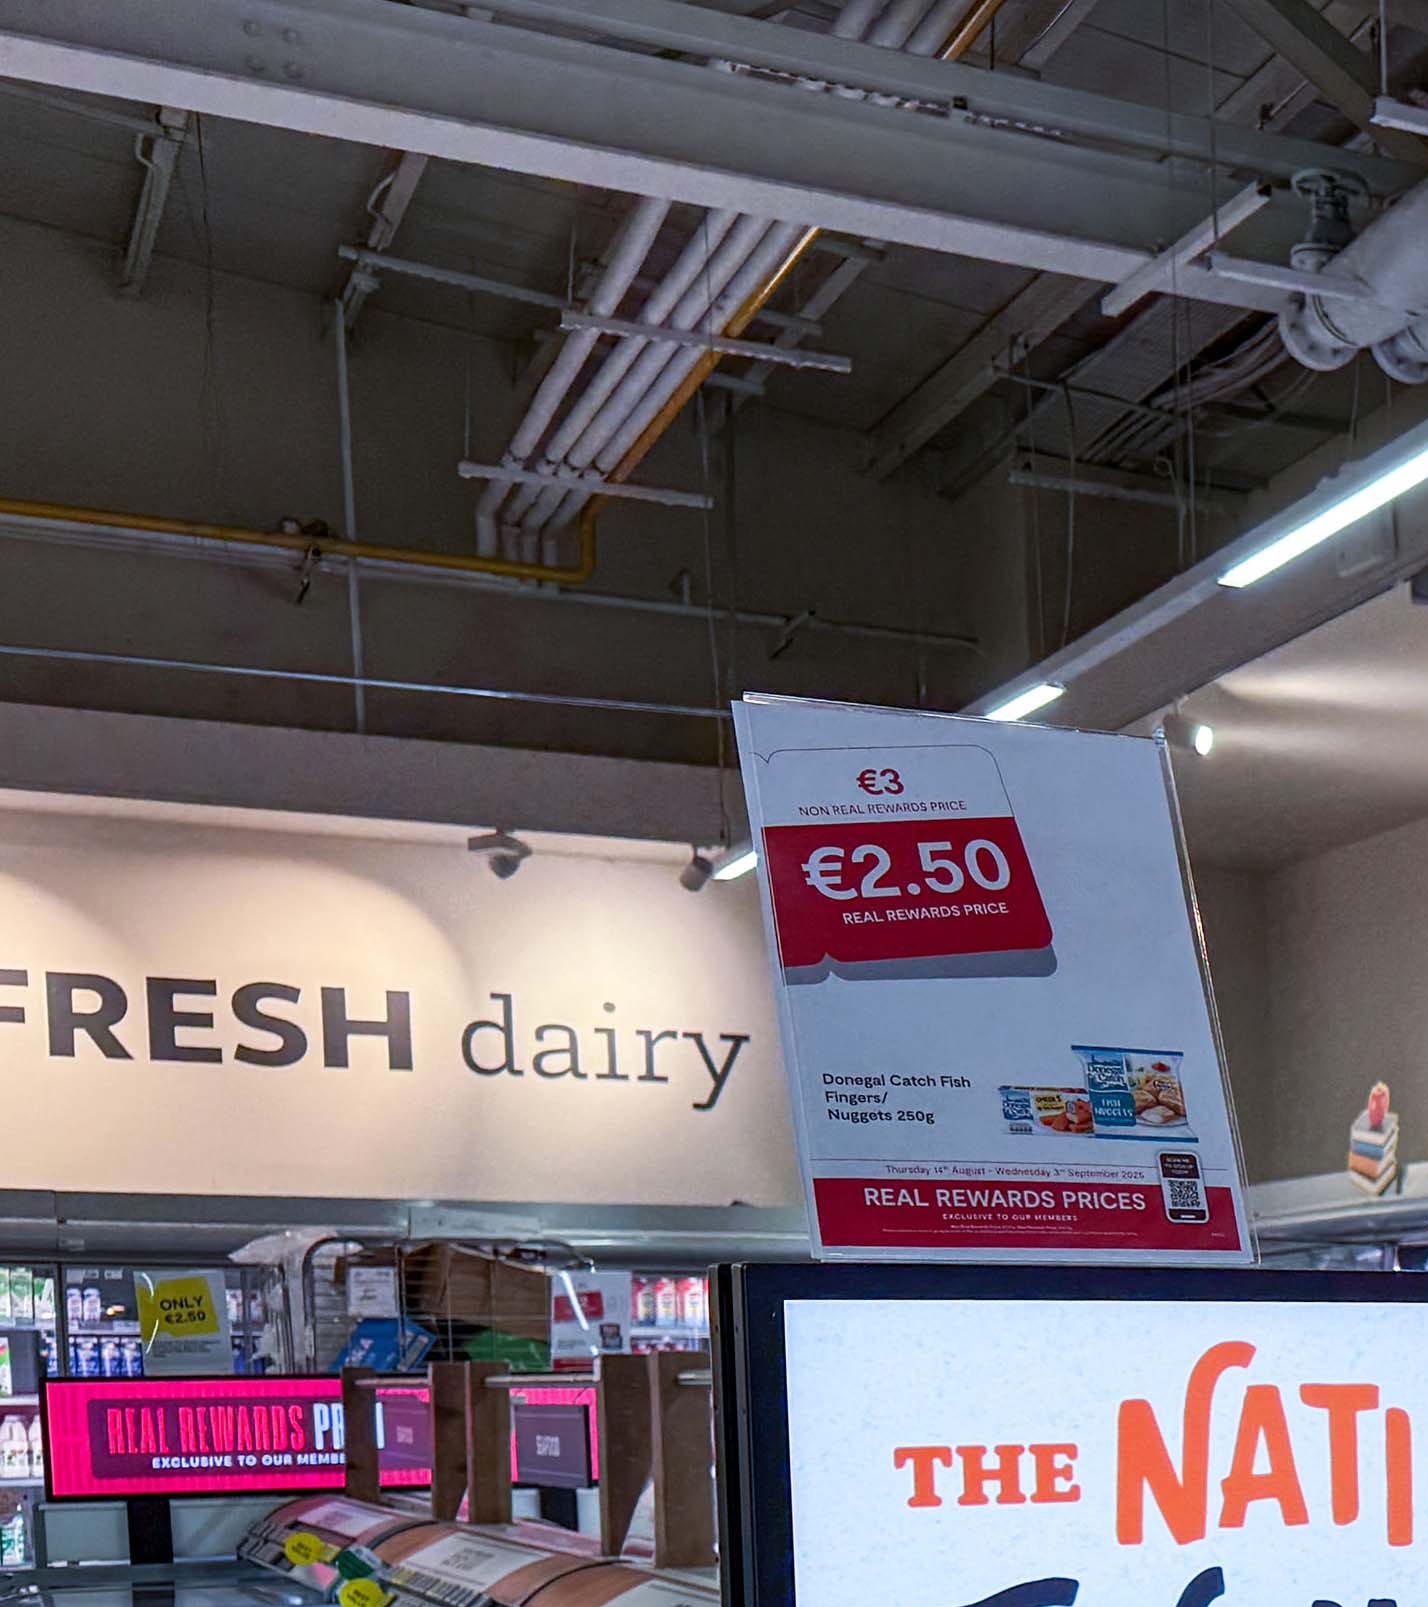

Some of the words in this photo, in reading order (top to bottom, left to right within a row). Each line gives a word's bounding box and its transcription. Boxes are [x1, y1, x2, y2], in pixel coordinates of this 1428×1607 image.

[857, 768, 904, 795] €3
[799, 804, 829, 817] NON
[833, 803, 864, 816] REAL
[867, 801, 926, 815] REWARDS
[930, 800, 966, 813] PRICE
[802, 838, 1010, 900] €2.50
[843, 911, 883, 926] REAL
[887, 905, 960, 922] REWARDS
[964, 902, 1009, 916] PRICE
[461, 993, 750, 1110] dairy
[822, 1074, 884, 1088] Donegal
[890, 1074, 936, 1086] Catch
[940, 1076, 971, 1088] Fish
[825, 1091, 888, 1106] Fingers/
[828, 1109, 892, 1124] Nuggets
[897, 1110, 935, 1124] 250g
[886, 1164, 931, 1176] Thursday
[951, 1166, 986, 1178] August
[995, 1167, 1051, 1178] Wednesday
[1068, 1169, 1119, 1180] September
[864, 1188, 929, 1207] REAL
[936, 1190, 1055, 1209] REWARDS
[1063, 1192, 1146, 1210] PRICES
[942, 1213, 994, 1222] EXCLUSIVE
[996, 1214, 1008, 1222] TO
[1012, 1214, 1030, 1222] OUR
[1034, 1214, 1078, 1223] MEMBERS
[160, 1296, 204, 1310] ONLY
[107, 1407, 169, 1455] REAL
[179, 1405, 305, 1453] REWARDS
[152, 1456, 232, 1468] EXCLUSIVE
[238, 1456, 256, 1467] TO
[262, 1454, 292, 1466] OUR
[893, 1442, 1080, 1509] THE
